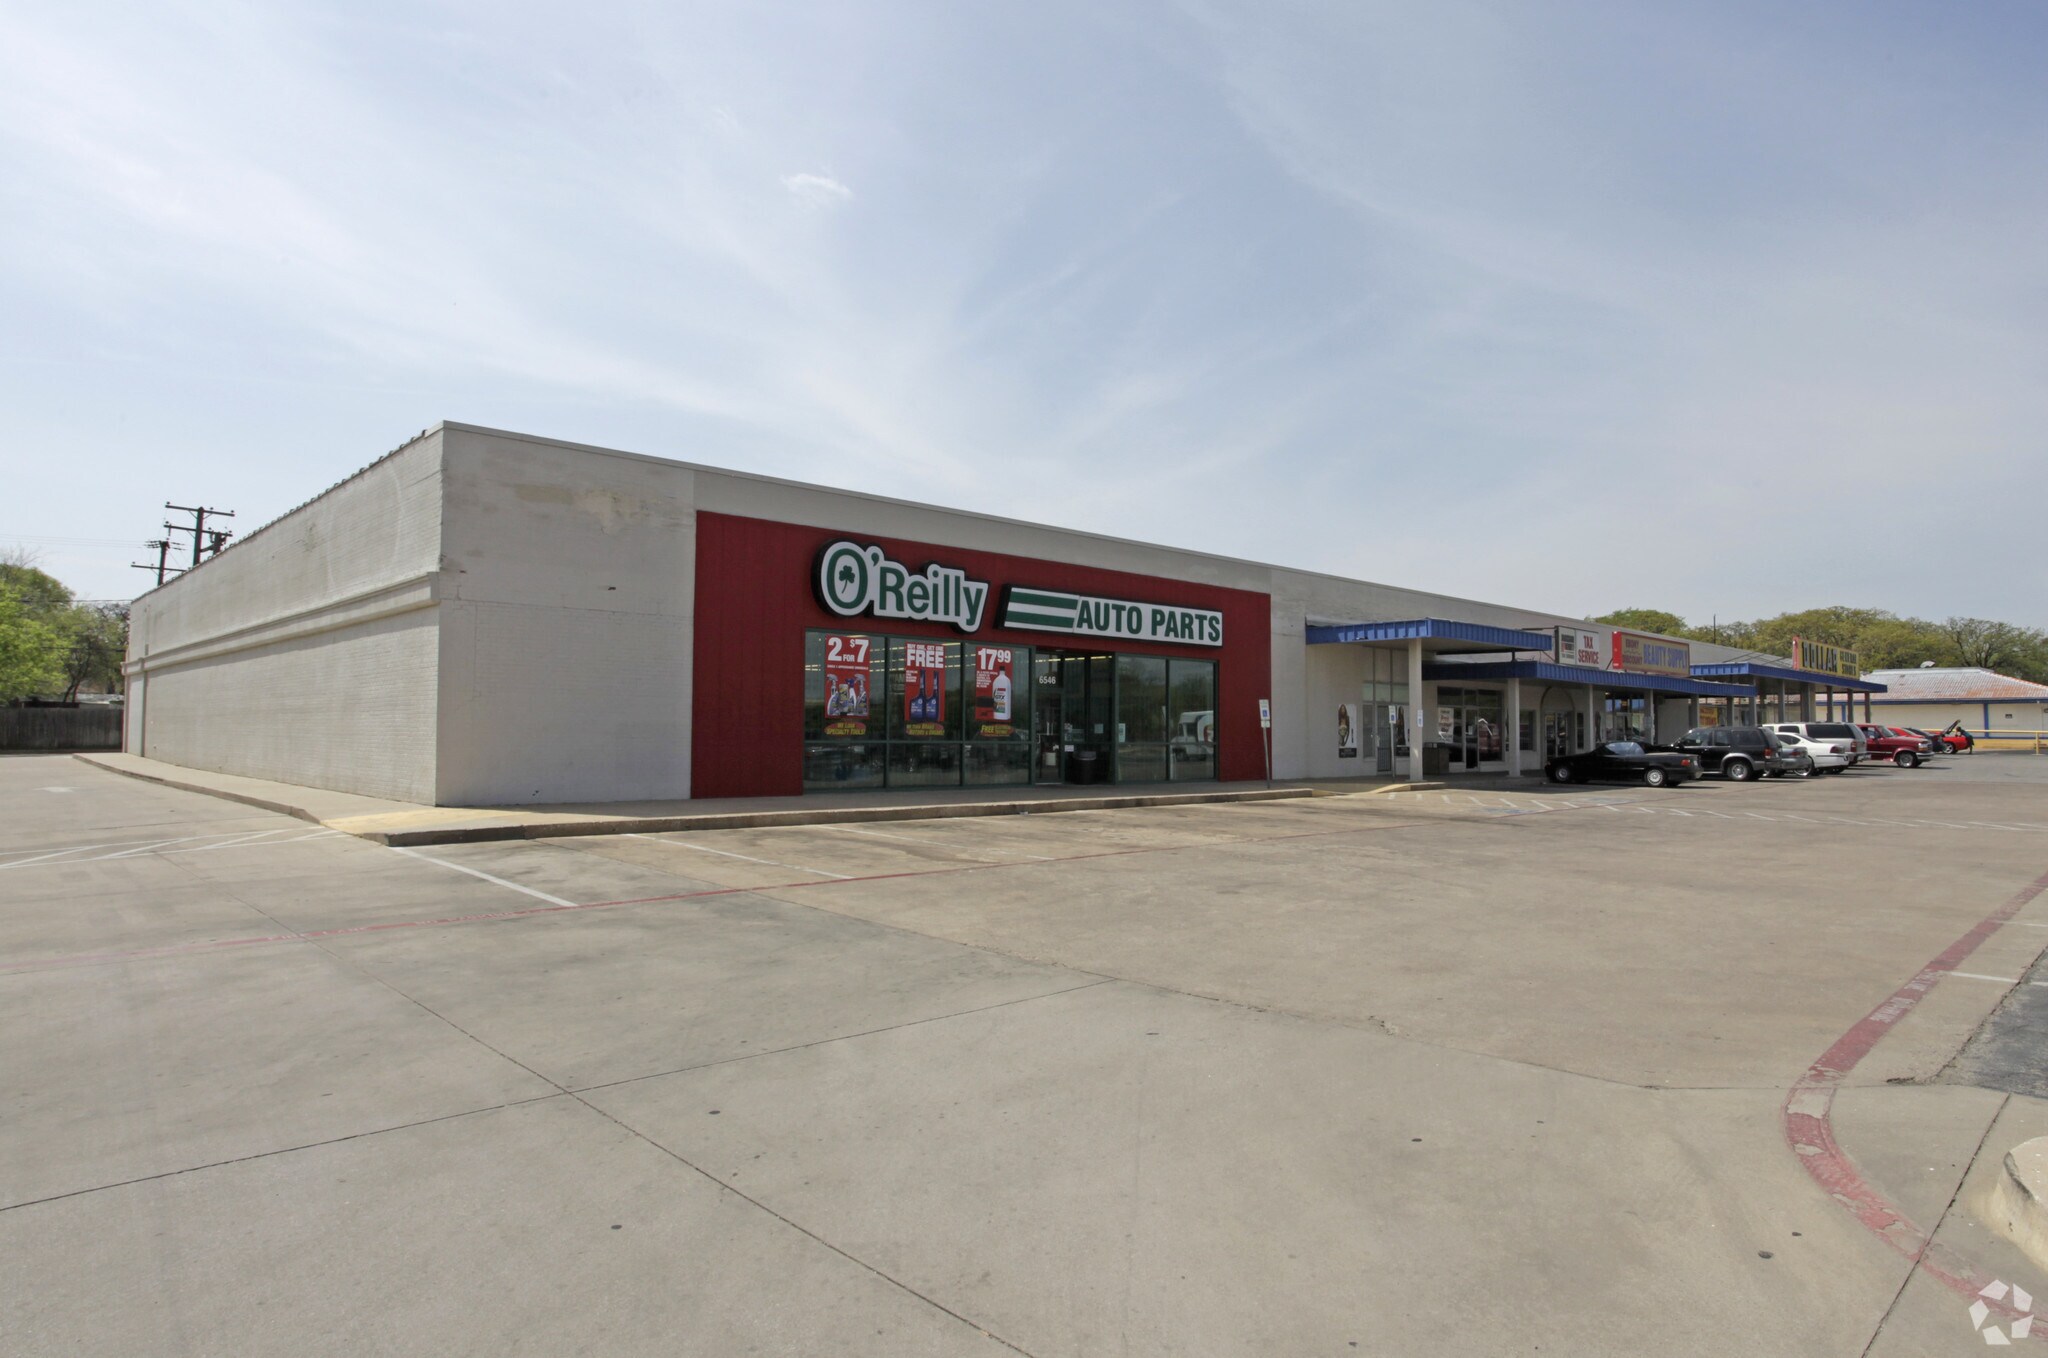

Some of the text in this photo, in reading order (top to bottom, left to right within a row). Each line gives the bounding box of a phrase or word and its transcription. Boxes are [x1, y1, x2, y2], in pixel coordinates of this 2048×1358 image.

[826, 548, 983, 626] O'Reilly
[1077, 600, 1221, 642] AUTO PARTS
[827, 637, 842, 662] 2
[843, 654, 855, 662] FOR
[1583, 635, 1593, 649] TAX
[906, 649, 944, 669] FREE
[1578, 649, 1599, 664] SERVICE
[1643, 644, 1688, 669] BEAUTY SUPPLY
[1801, 641, 1837, 673] DOLLAR
[1039, 675, 1056, 685] 6546
[981, 725, 995, 733] FREE
